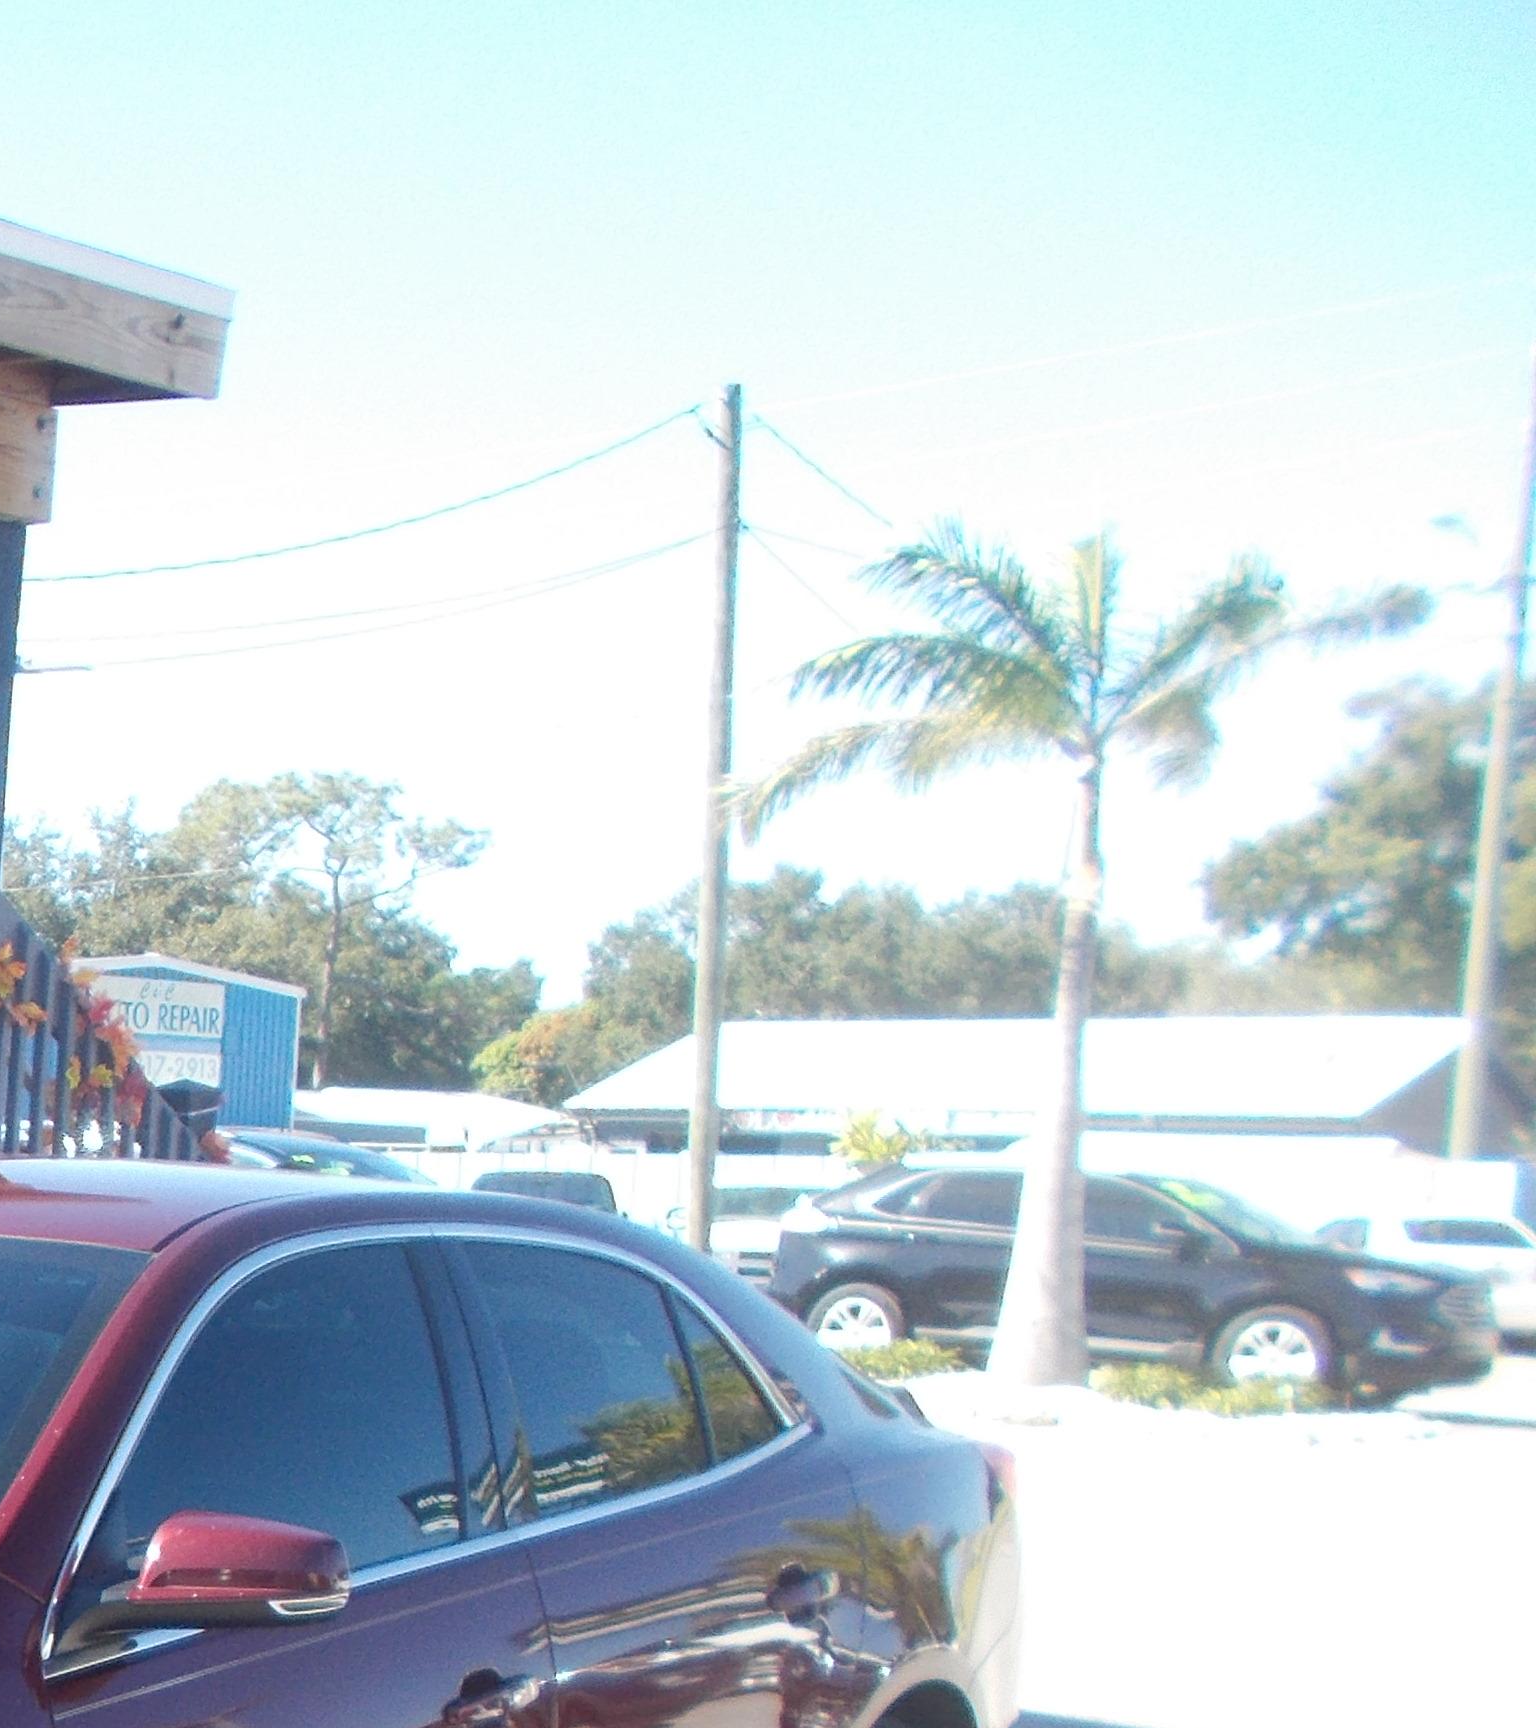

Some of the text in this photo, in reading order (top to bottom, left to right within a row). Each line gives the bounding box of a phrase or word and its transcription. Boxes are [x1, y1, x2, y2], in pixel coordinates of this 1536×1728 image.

[119, 1001, 220, 1035] TO REPAIR
[144, 1053, 217, 1080] 17-2913
